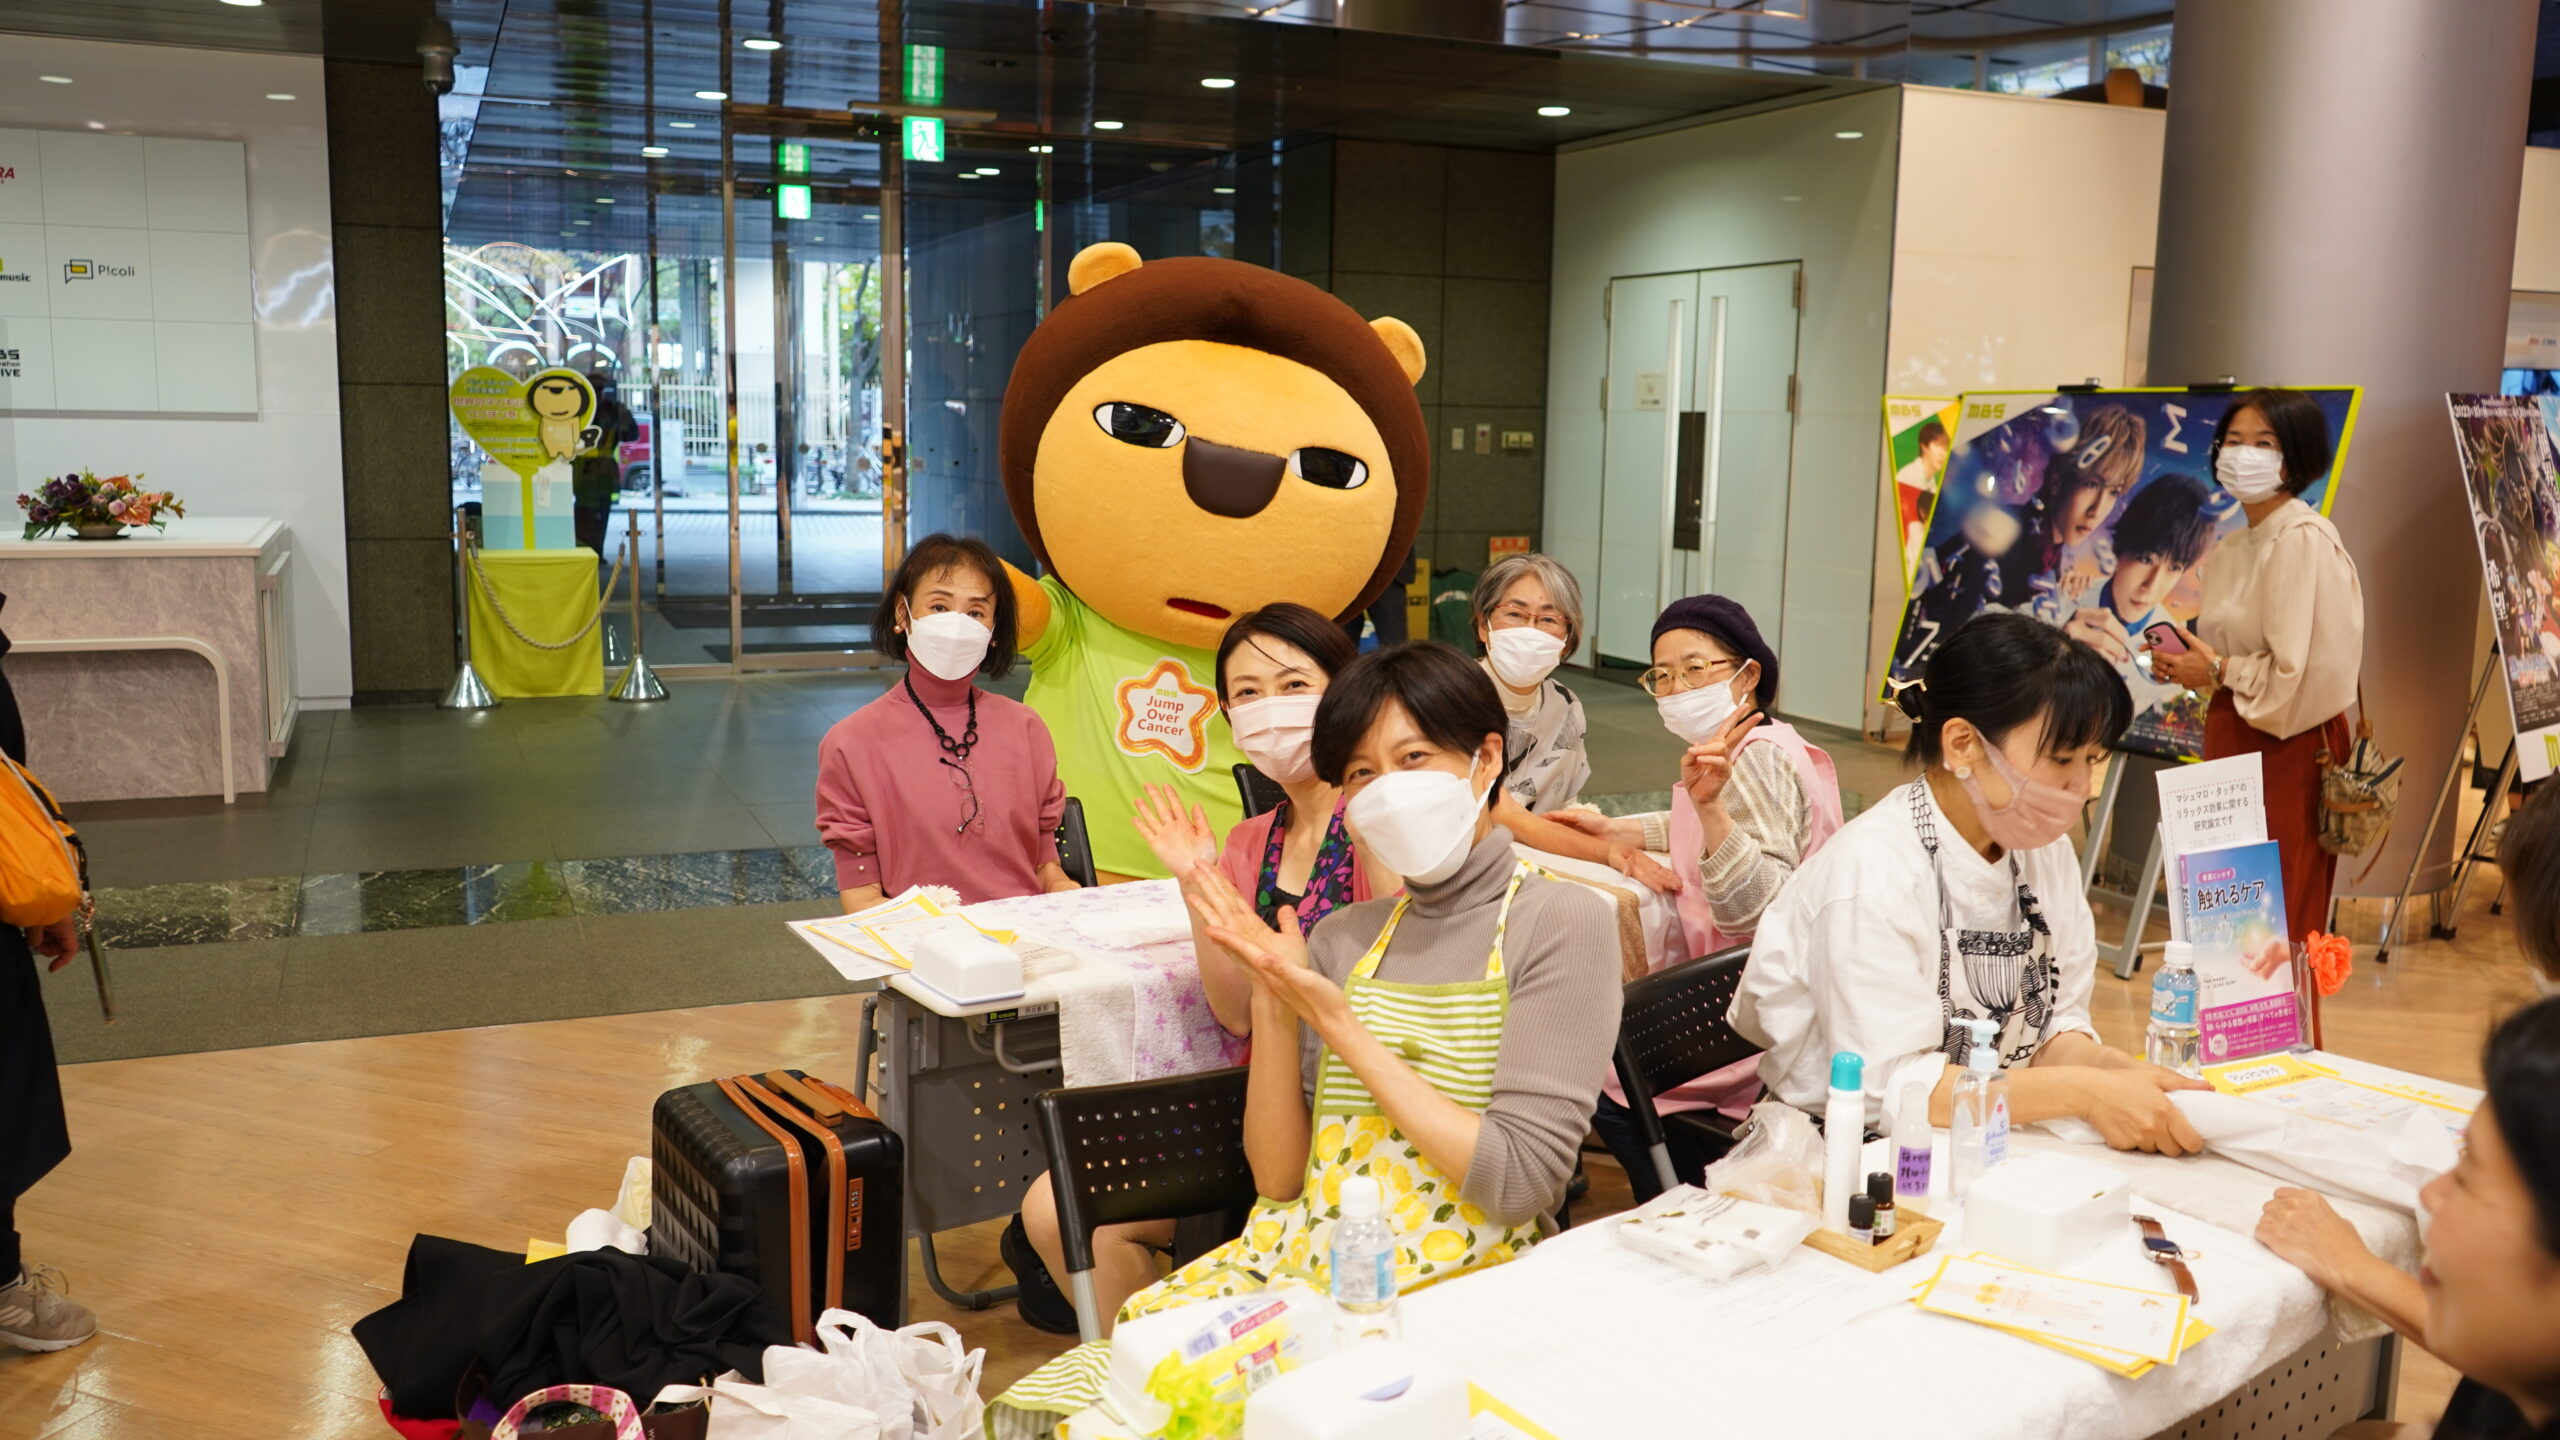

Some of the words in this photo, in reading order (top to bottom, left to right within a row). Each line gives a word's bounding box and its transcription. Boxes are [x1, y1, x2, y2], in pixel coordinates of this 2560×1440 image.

[1966, 402, 2007, 419] MBS
[1146, 695, 1184, 712] Jump
[1146, 708, 1180, 724] Over
[1137, 718, 1185, 736] Cancer
[2176, 796, 2249, 820] リラックス効果に関する
[2193, 815, 2234, 832] 研究論文です
[2197, 880, 2265, 912] 触れるケア
